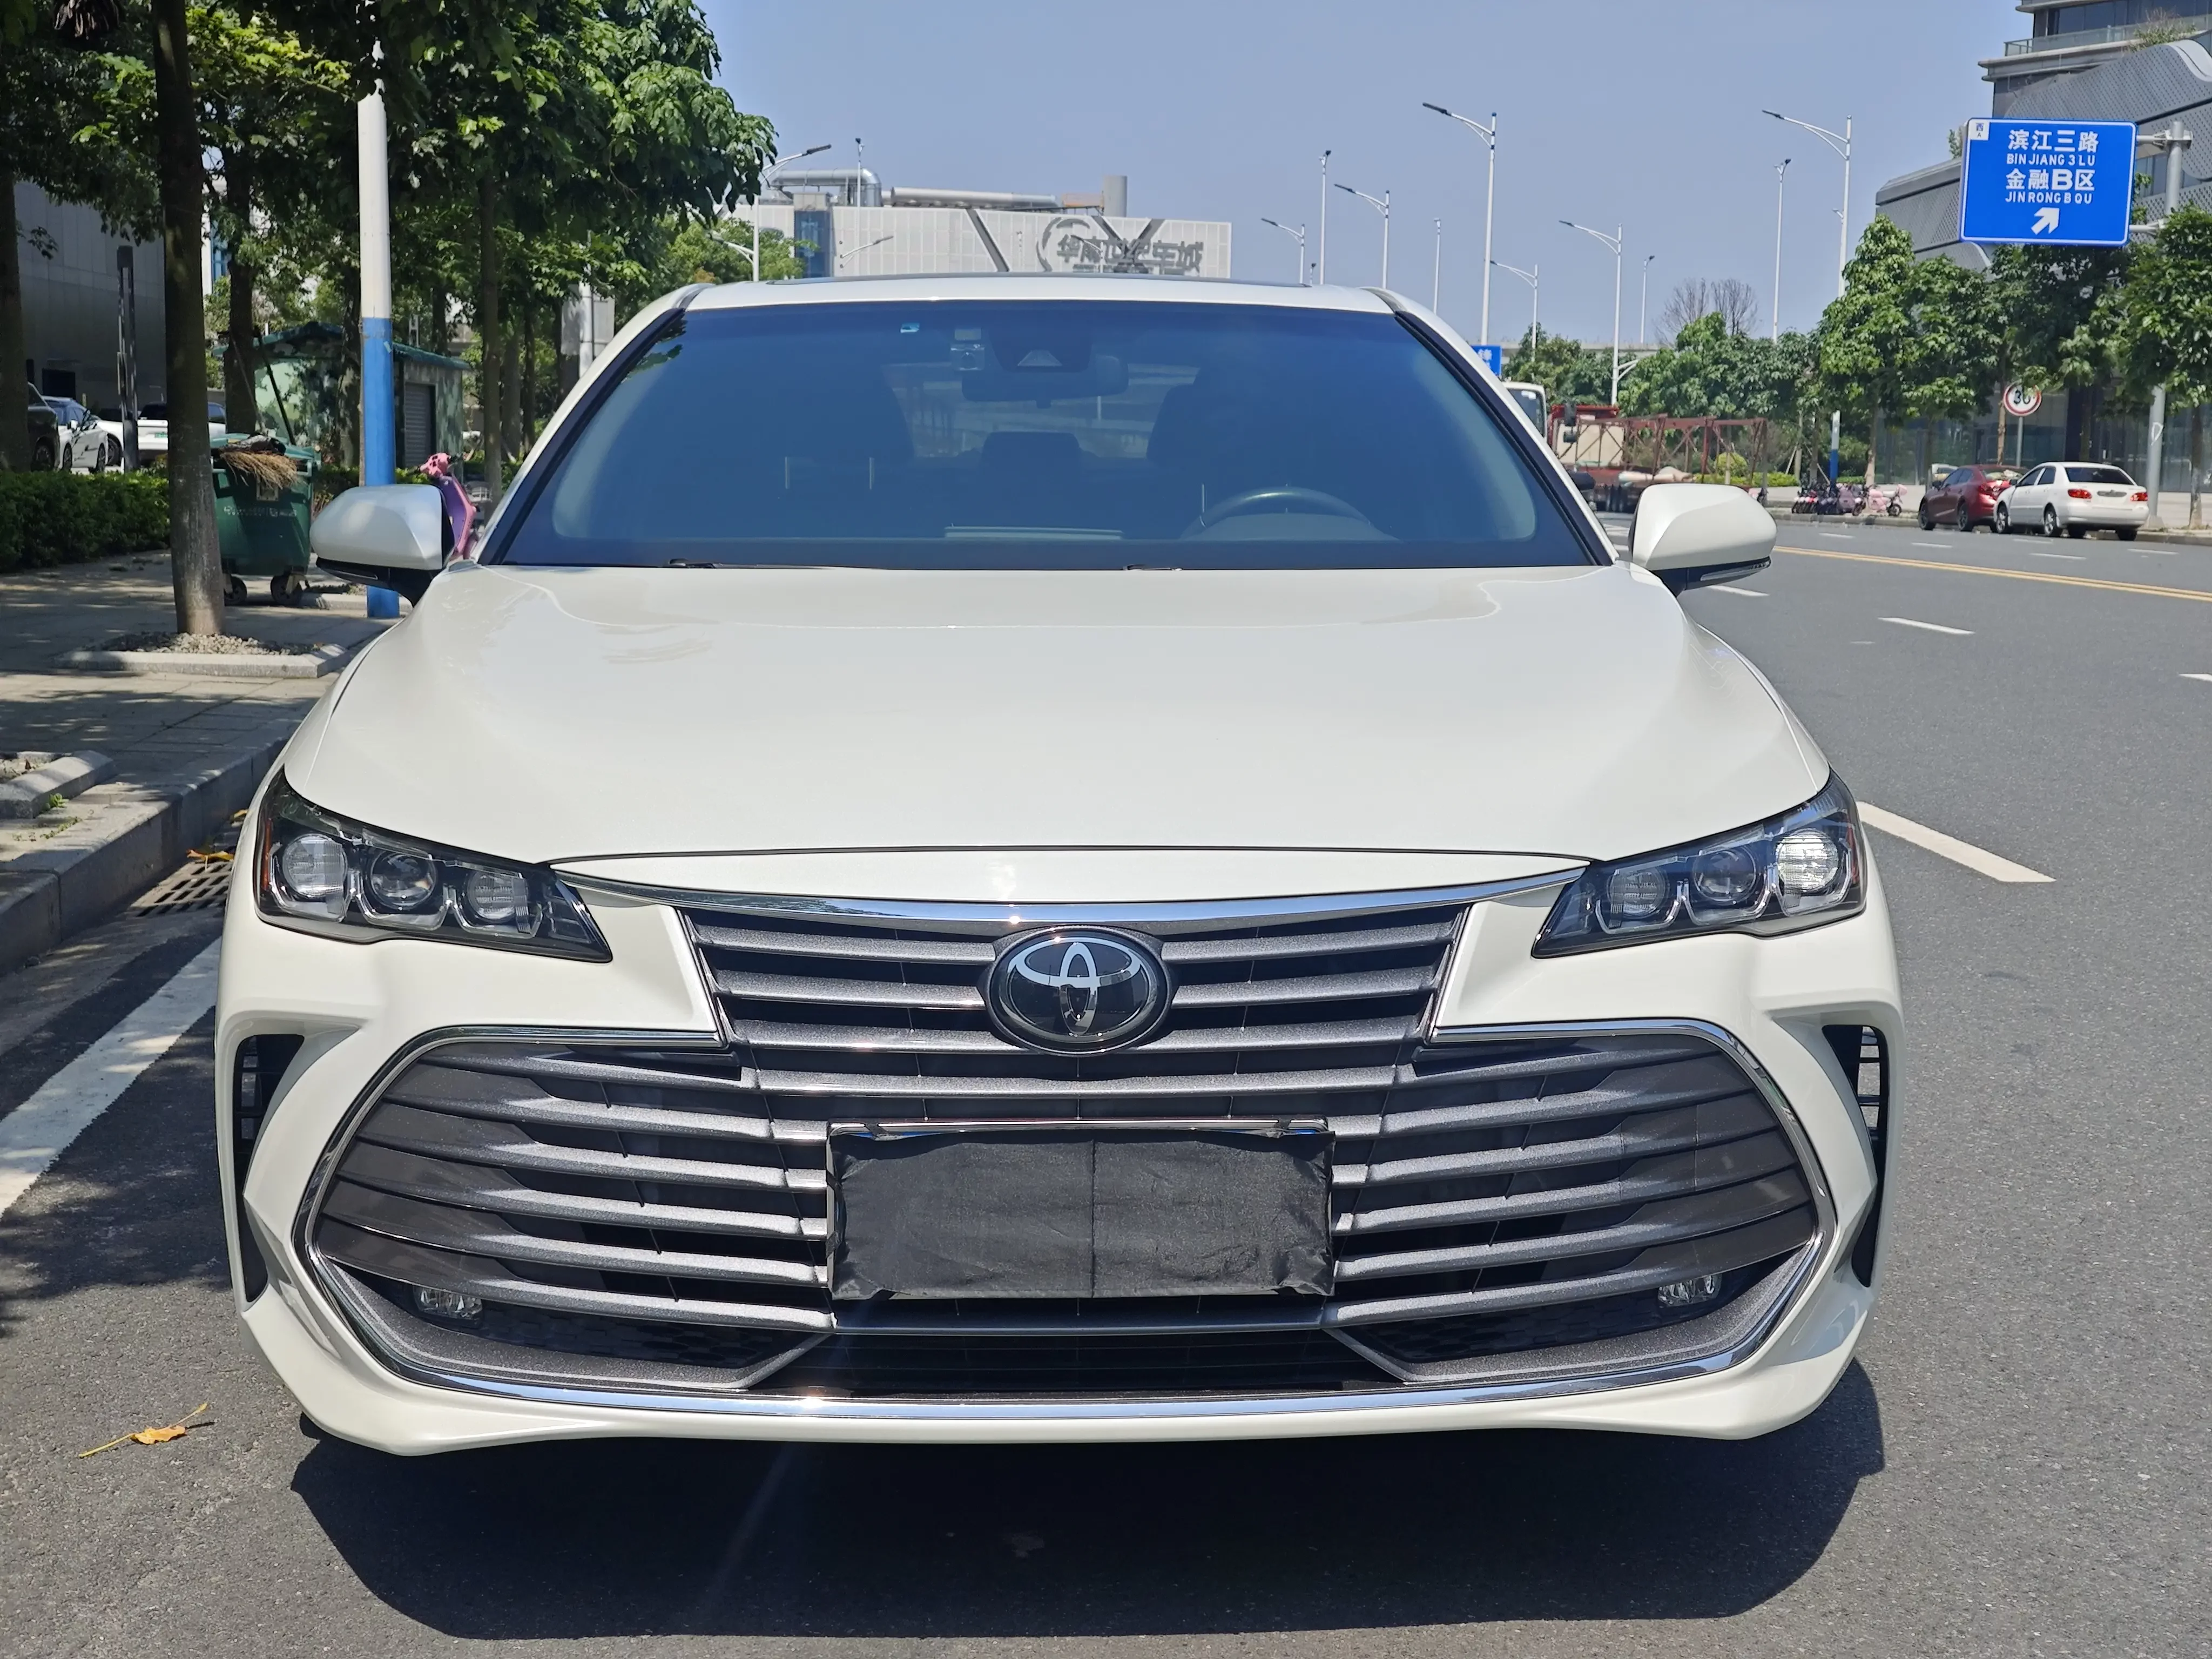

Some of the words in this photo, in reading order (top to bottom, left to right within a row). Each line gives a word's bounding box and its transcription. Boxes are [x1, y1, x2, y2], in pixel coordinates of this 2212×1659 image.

[2008, 129, 2099, 153] 滨江三路
[2006, 153, 2026, 164] BIN
[2028, 153, 2065, 166] JIANG
[2068, 154, 2075, 166] 3
[2079, 154, 2095, 166] LU
[2006, 168, 2095, 191] 金融B区
[2005, 191, 2026, 203] JIN
[2028, 192, 2061, 204] RONG
[2063, 192, 2072, 204] B
